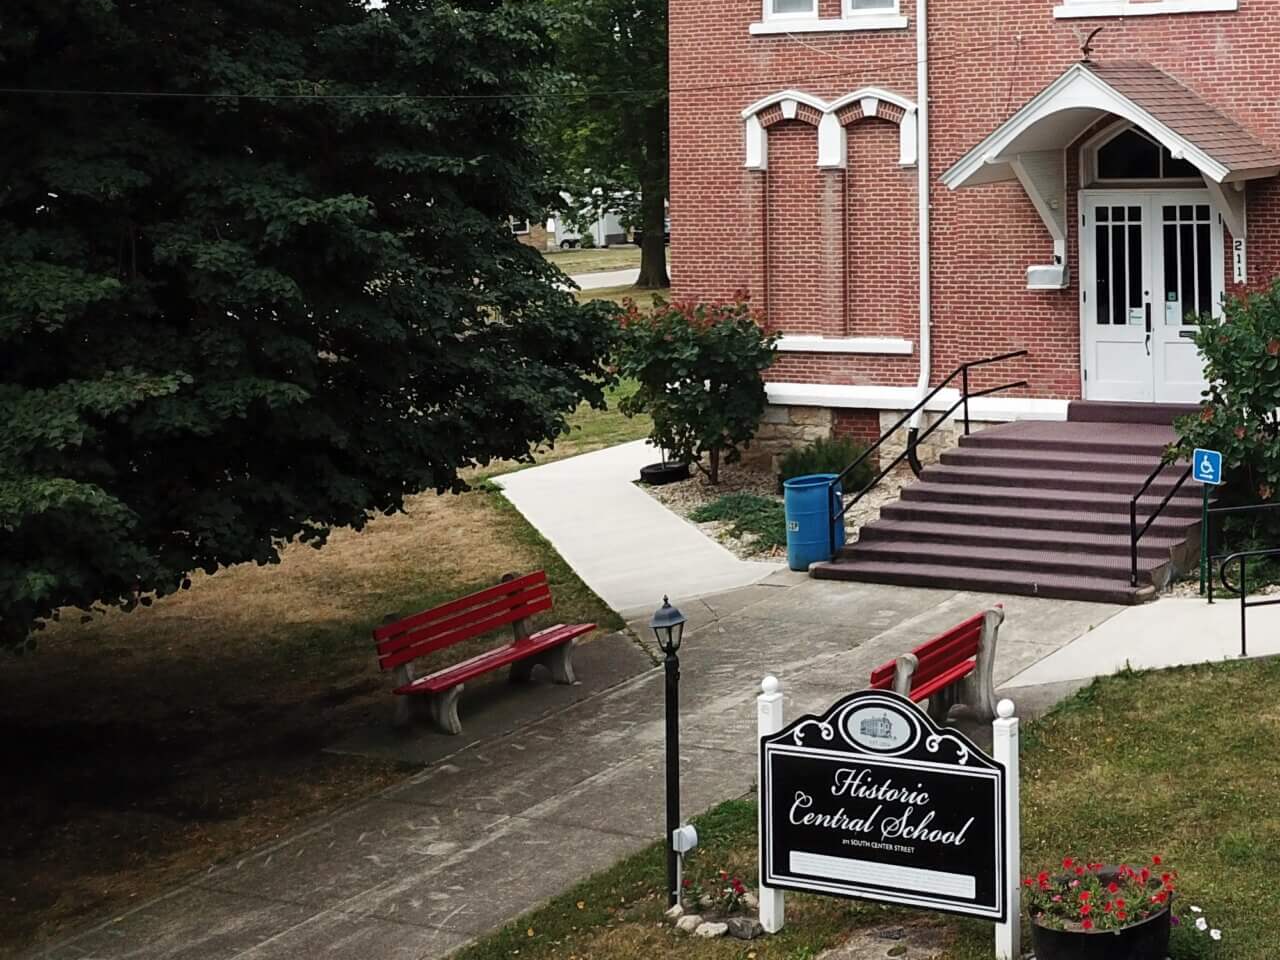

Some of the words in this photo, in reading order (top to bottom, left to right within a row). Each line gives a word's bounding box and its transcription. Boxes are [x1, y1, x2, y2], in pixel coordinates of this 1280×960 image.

[831, 768, 929, 805] Historic
[789, 791, 882, 832] Central
[881, 805, 974, 845] School
[850, 839, 871, 848] SOUTH
[871, 841, 893, 851] CENTER
[894, 844, 915, 854] STREET
